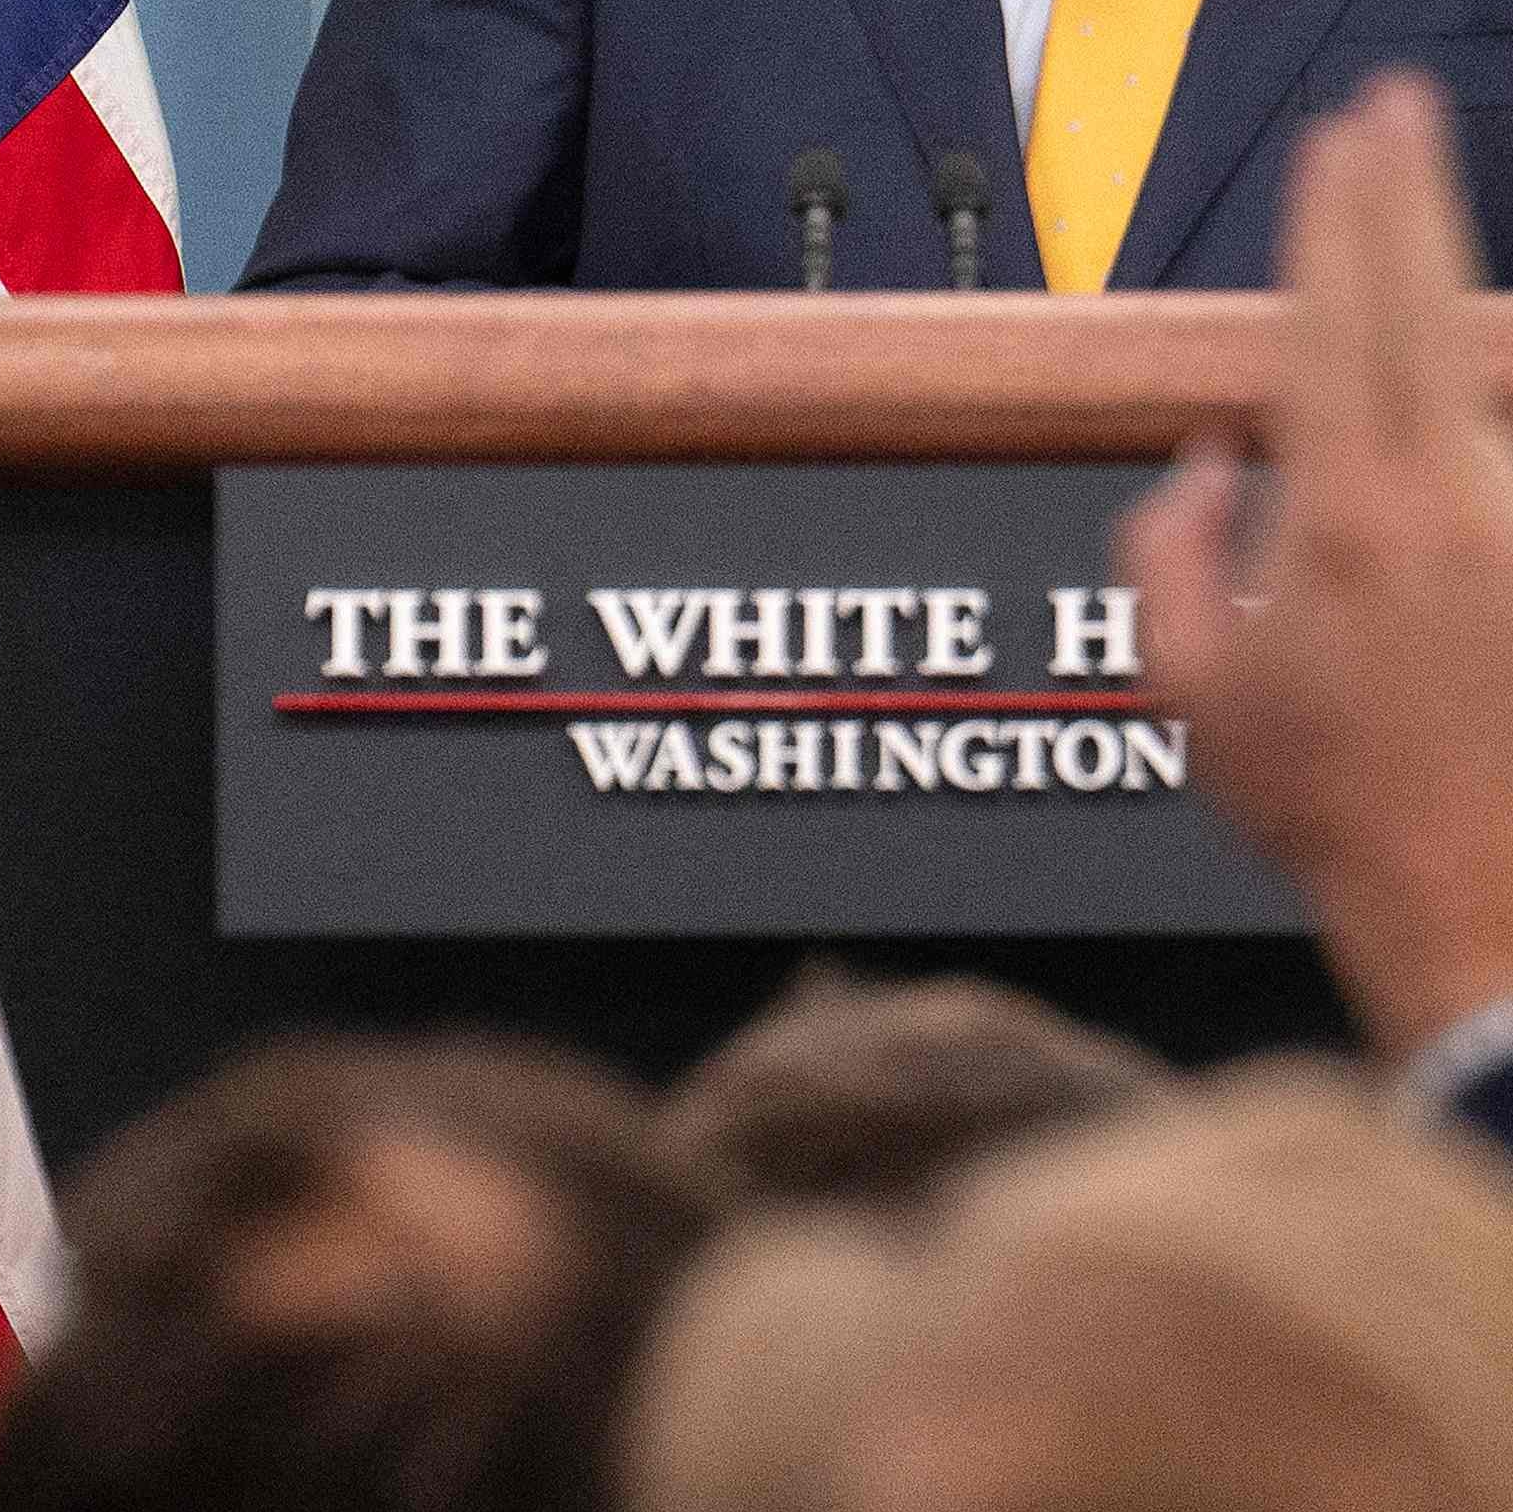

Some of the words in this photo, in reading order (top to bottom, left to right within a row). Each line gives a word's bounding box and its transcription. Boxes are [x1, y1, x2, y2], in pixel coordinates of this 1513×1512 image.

[304, 586, 549, 680] THE
[586, 586, 994, 680] WHITE
[566, 719, 1188, 793] WASHINGTON
